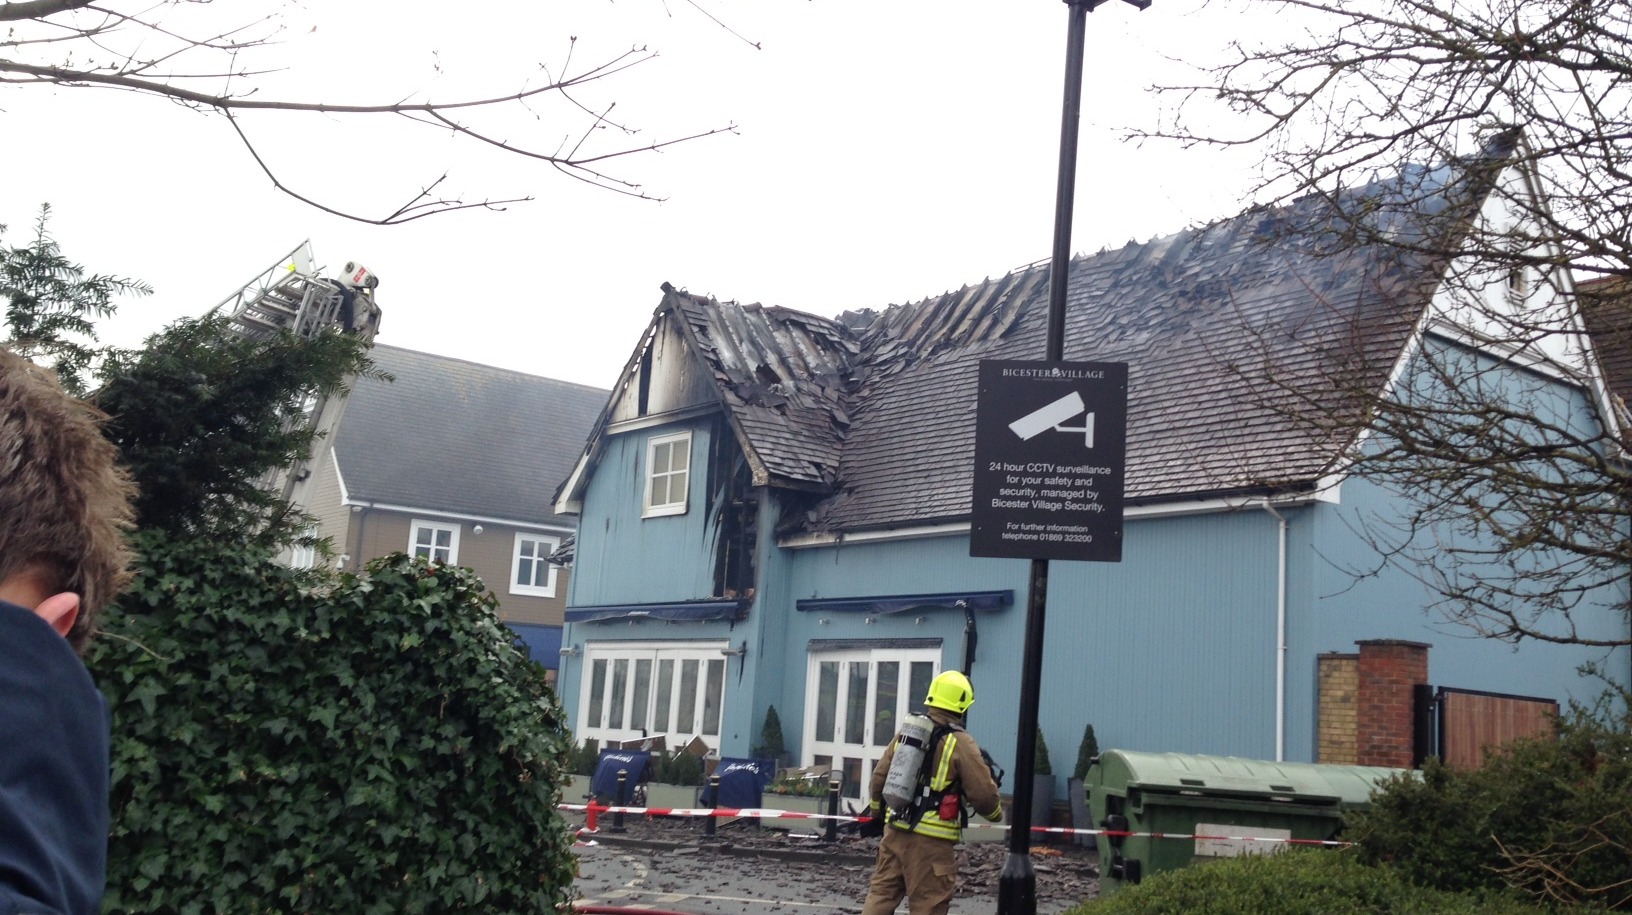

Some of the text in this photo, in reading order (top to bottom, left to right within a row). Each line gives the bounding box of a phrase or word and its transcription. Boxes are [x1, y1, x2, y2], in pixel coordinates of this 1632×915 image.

[1002, 368, 1105, 379] BICESTER VILLAGE
[989, 462, 1112, 475] 24 hour CCTV surveillance
[1006, 475, 1093, 488] for your safety and
[999, 487, 1099, 501] security, managed by
[991, 498, 1106, 513] Bicester Village Security.
[1006, 522, 1089, 533] For further information
[1001, 532, 1039, 541] telephone
